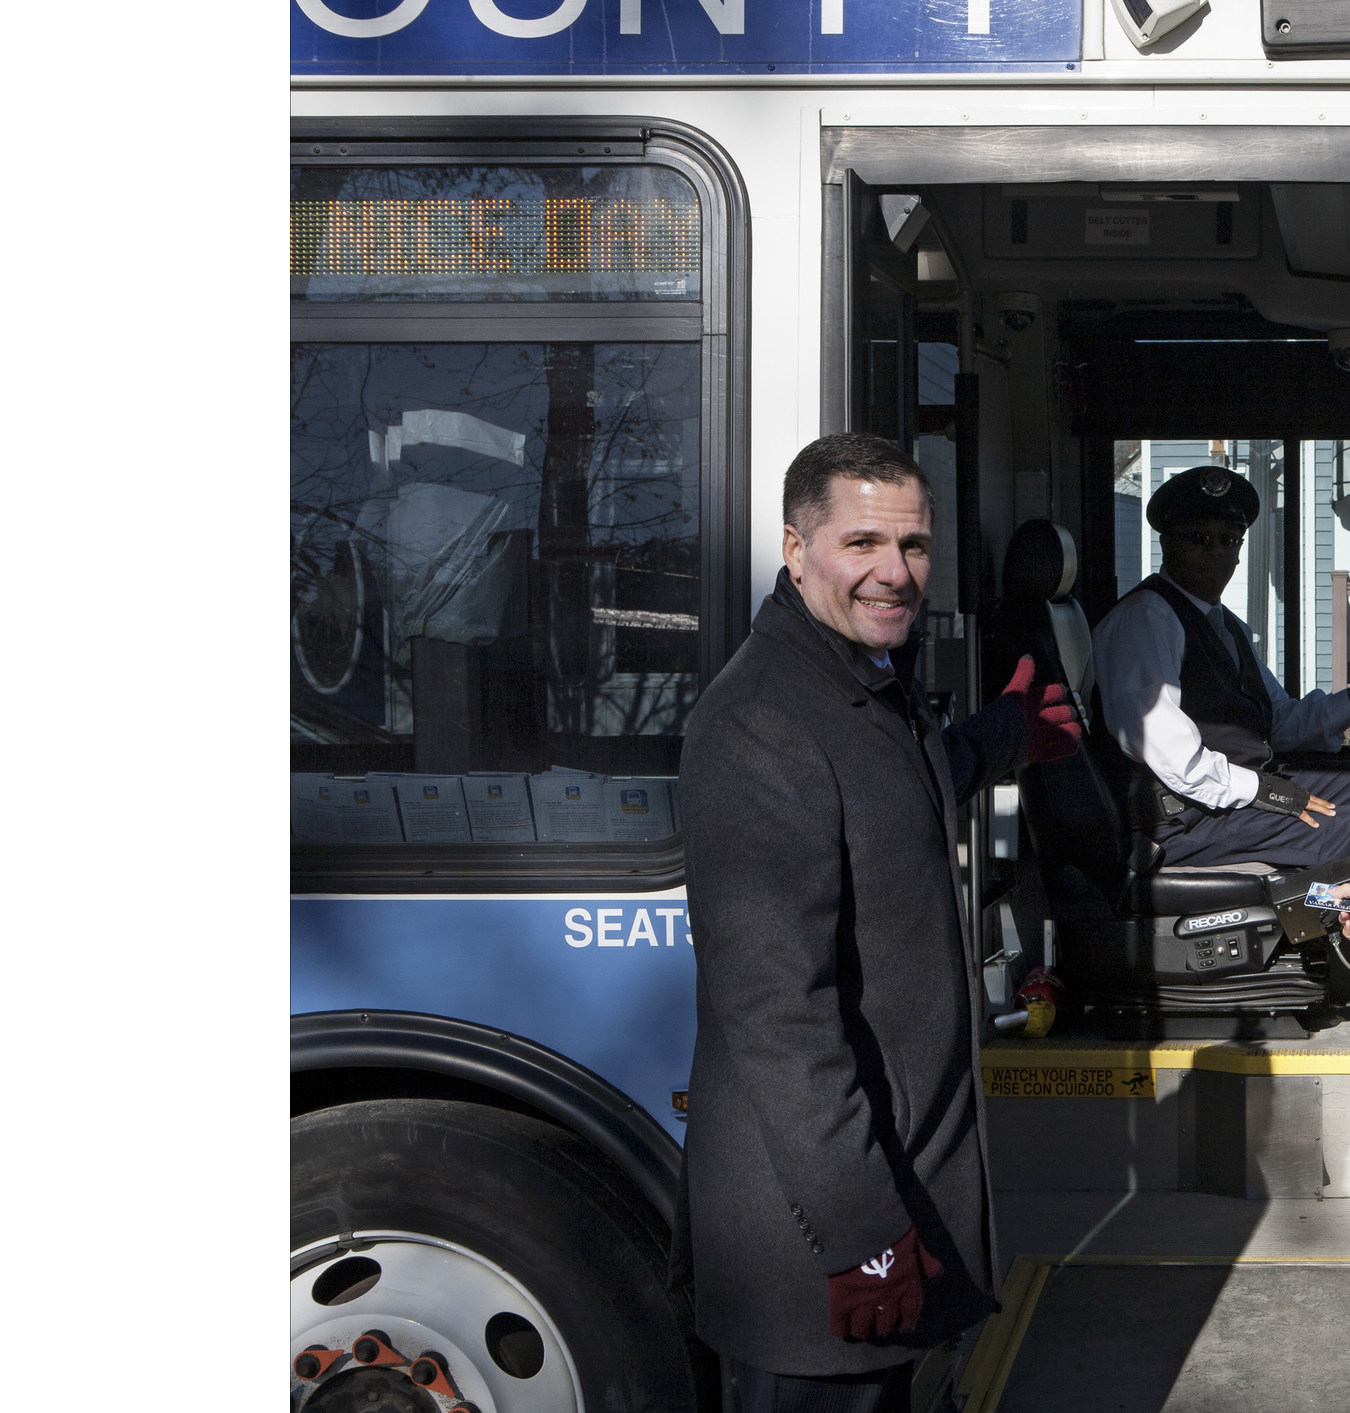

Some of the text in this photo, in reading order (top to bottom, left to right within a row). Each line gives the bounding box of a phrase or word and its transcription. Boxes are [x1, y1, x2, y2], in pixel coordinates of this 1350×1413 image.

[1088, 216, 1148, 225] BELT CUTTER
[328, 199, 700, 270] NICE DAY
[1103, 229, 1132, 238] INSIDE
[564, 907, 694, 948] SEAT
[1189, 911, 1242, 930] RECARO
[992, 1069, 1113, 1083] WATCH YOUR STEP
[991, 1082, 1114, 1096] PISE CON CUIDADO
